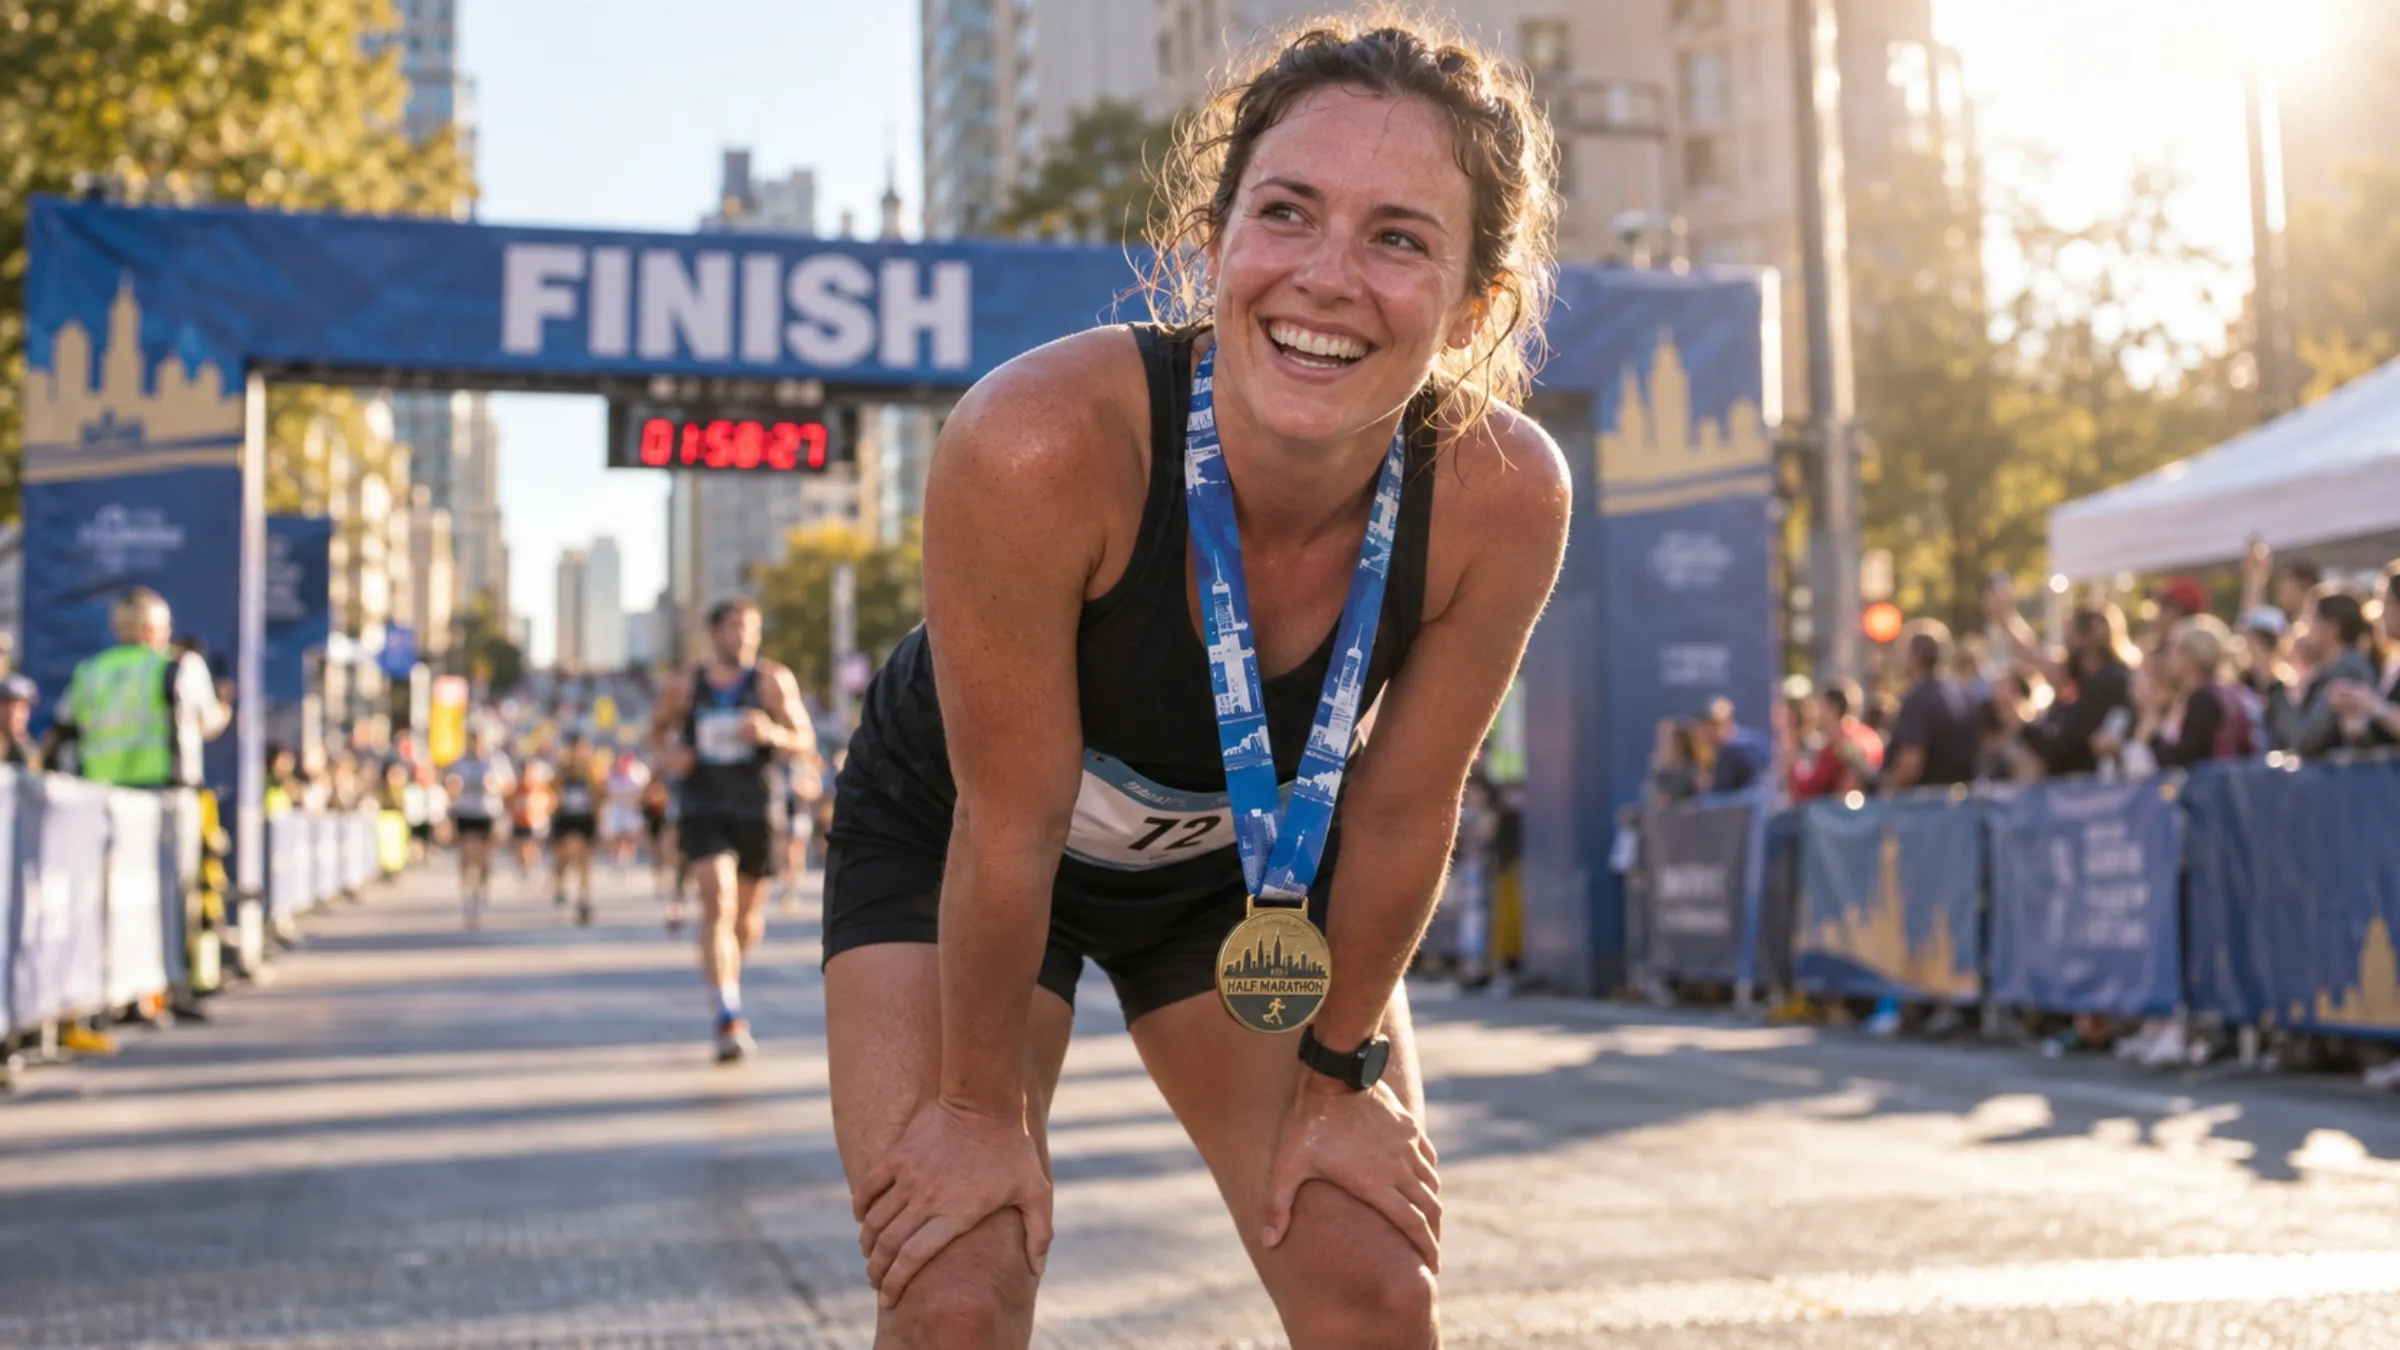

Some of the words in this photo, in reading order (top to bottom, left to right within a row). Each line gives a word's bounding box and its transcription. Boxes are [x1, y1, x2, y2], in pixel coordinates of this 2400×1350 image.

[502, 244, 971, 368] FINISH
[1128, 815, 1221, 851] 72
[1227, 981, 1258, 993] HALF
[1260, 980, 1323, 993] MARATHON
